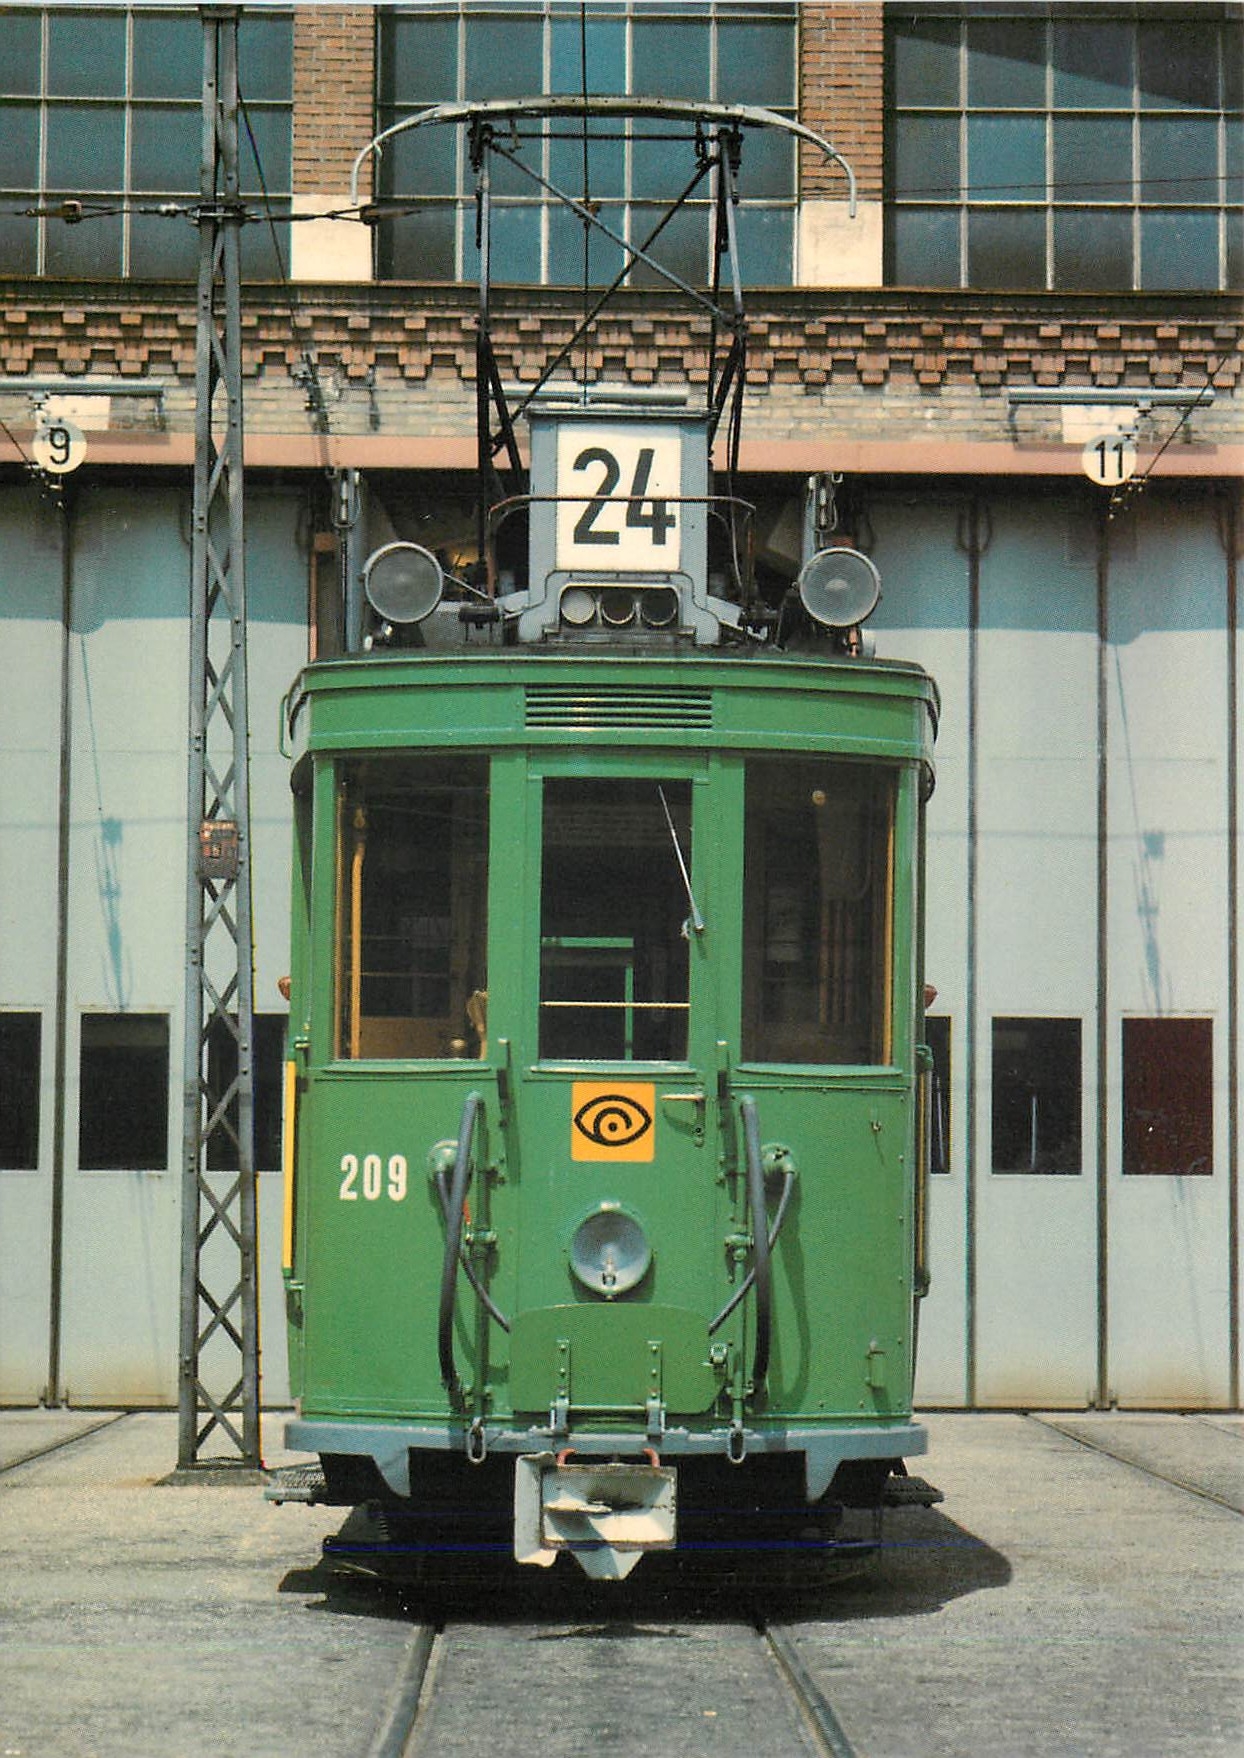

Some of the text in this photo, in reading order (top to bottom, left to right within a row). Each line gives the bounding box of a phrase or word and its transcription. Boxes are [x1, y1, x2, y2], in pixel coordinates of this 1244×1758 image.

[49, 427, 70, 465] 9
[1095, 440, 1123, 479] 11
[573, 447, 676, 545] 24
[340, 1154, 407, 1202] 209
